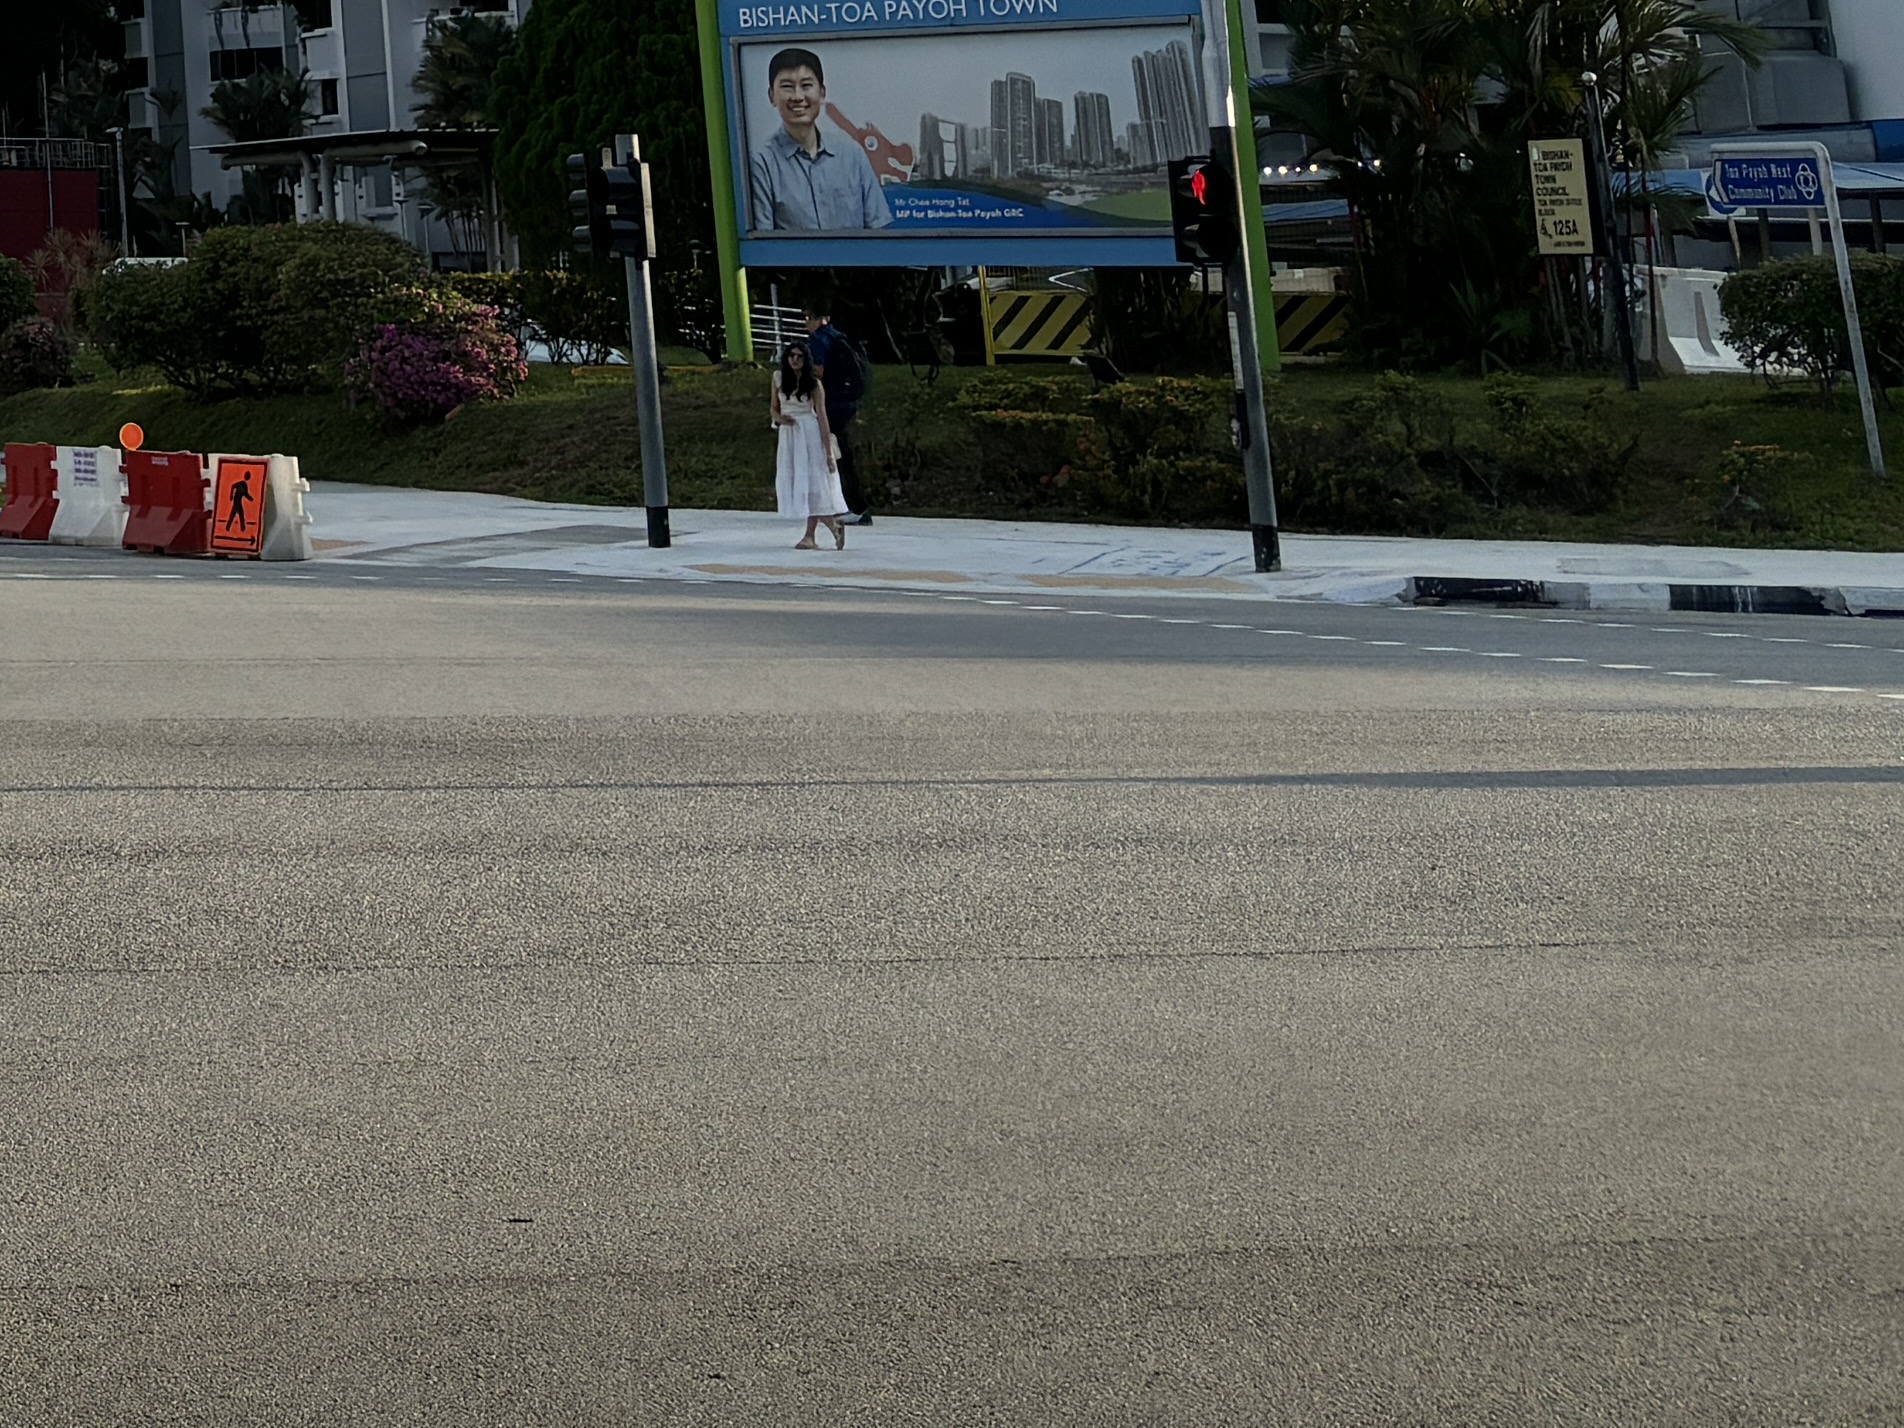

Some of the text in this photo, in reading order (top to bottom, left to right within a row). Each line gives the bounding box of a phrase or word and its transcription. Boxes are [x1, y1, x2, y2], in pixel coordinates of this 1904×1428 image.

[739, 0, 878, 28] BISHAN-TOA
[894, 198, 906, 206] Mr
[932, 198, 955, 208] Hong
[957, 196, 970, 206] Tat
[895, 209, 911, 219] MP
[912, 209, 925, 219] for
[974, 208, 1002, 220] Payoh
[1003, 208, 1024, 218] GRC
[1552, 219, 1579, 236] 125A
